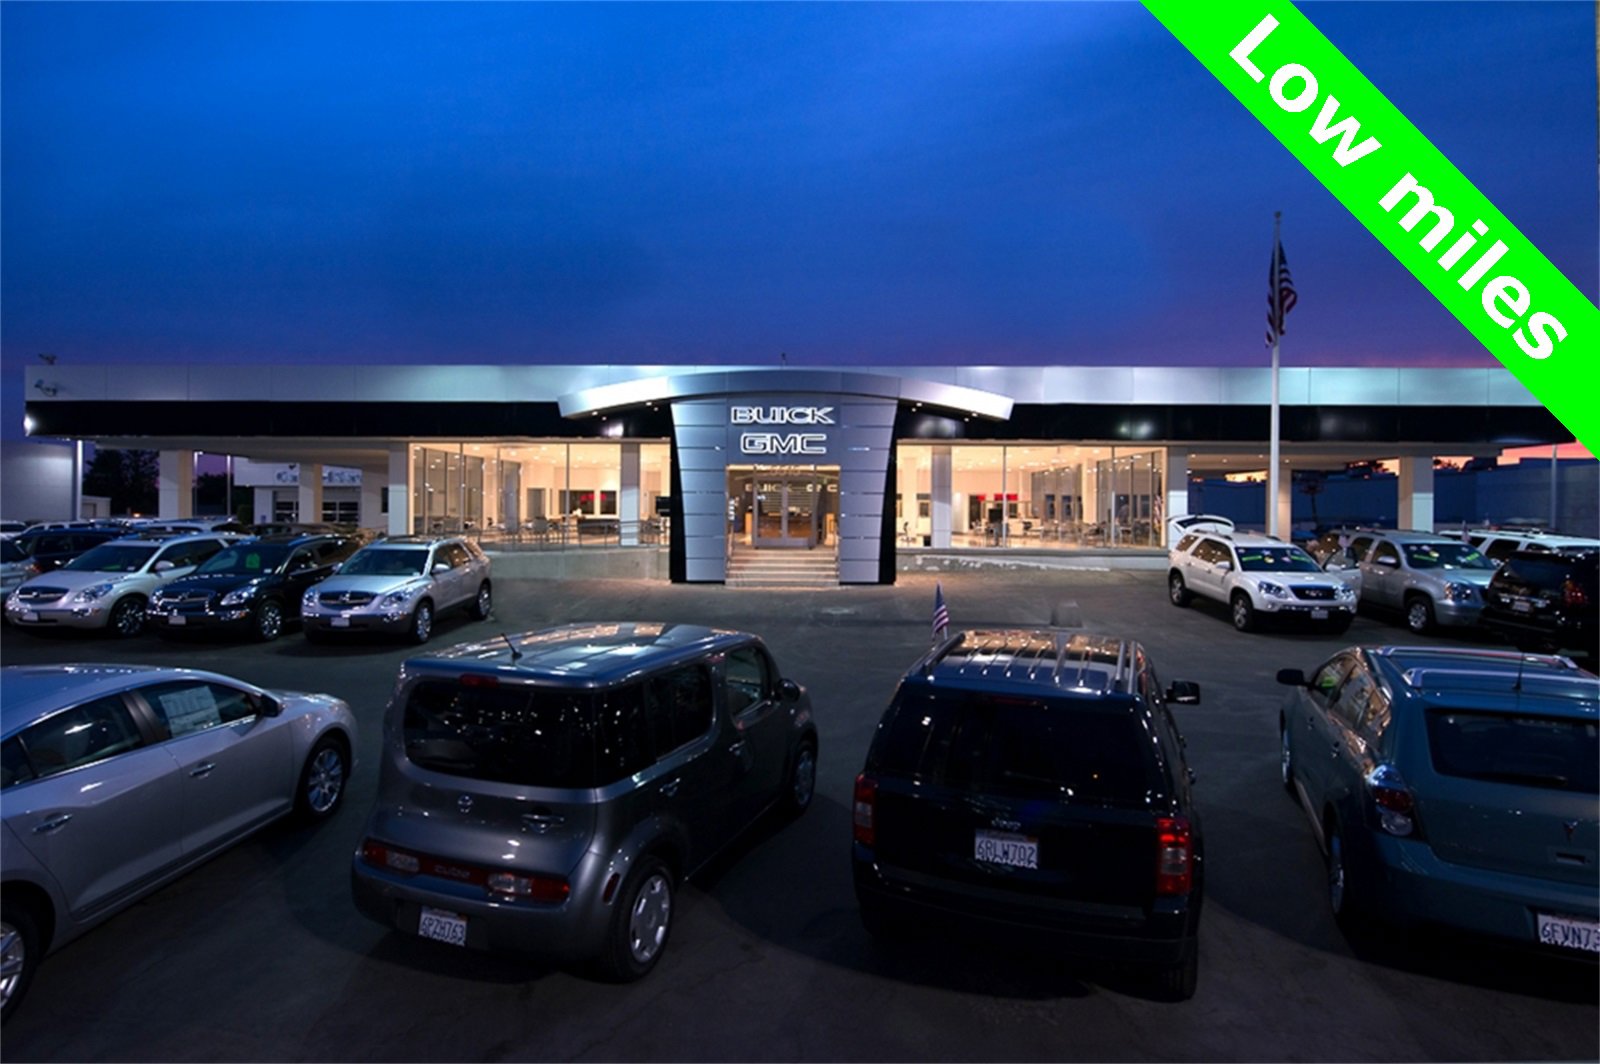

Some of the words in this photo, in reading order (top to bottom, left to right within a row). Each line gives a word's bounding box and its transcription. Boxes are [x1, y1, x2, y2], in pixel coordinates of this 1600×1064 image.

[731, 406, 836, 425] BUICK
[740, 432, 827, 455] GMC
[977, 840, 1036, 863] 6RLW702
